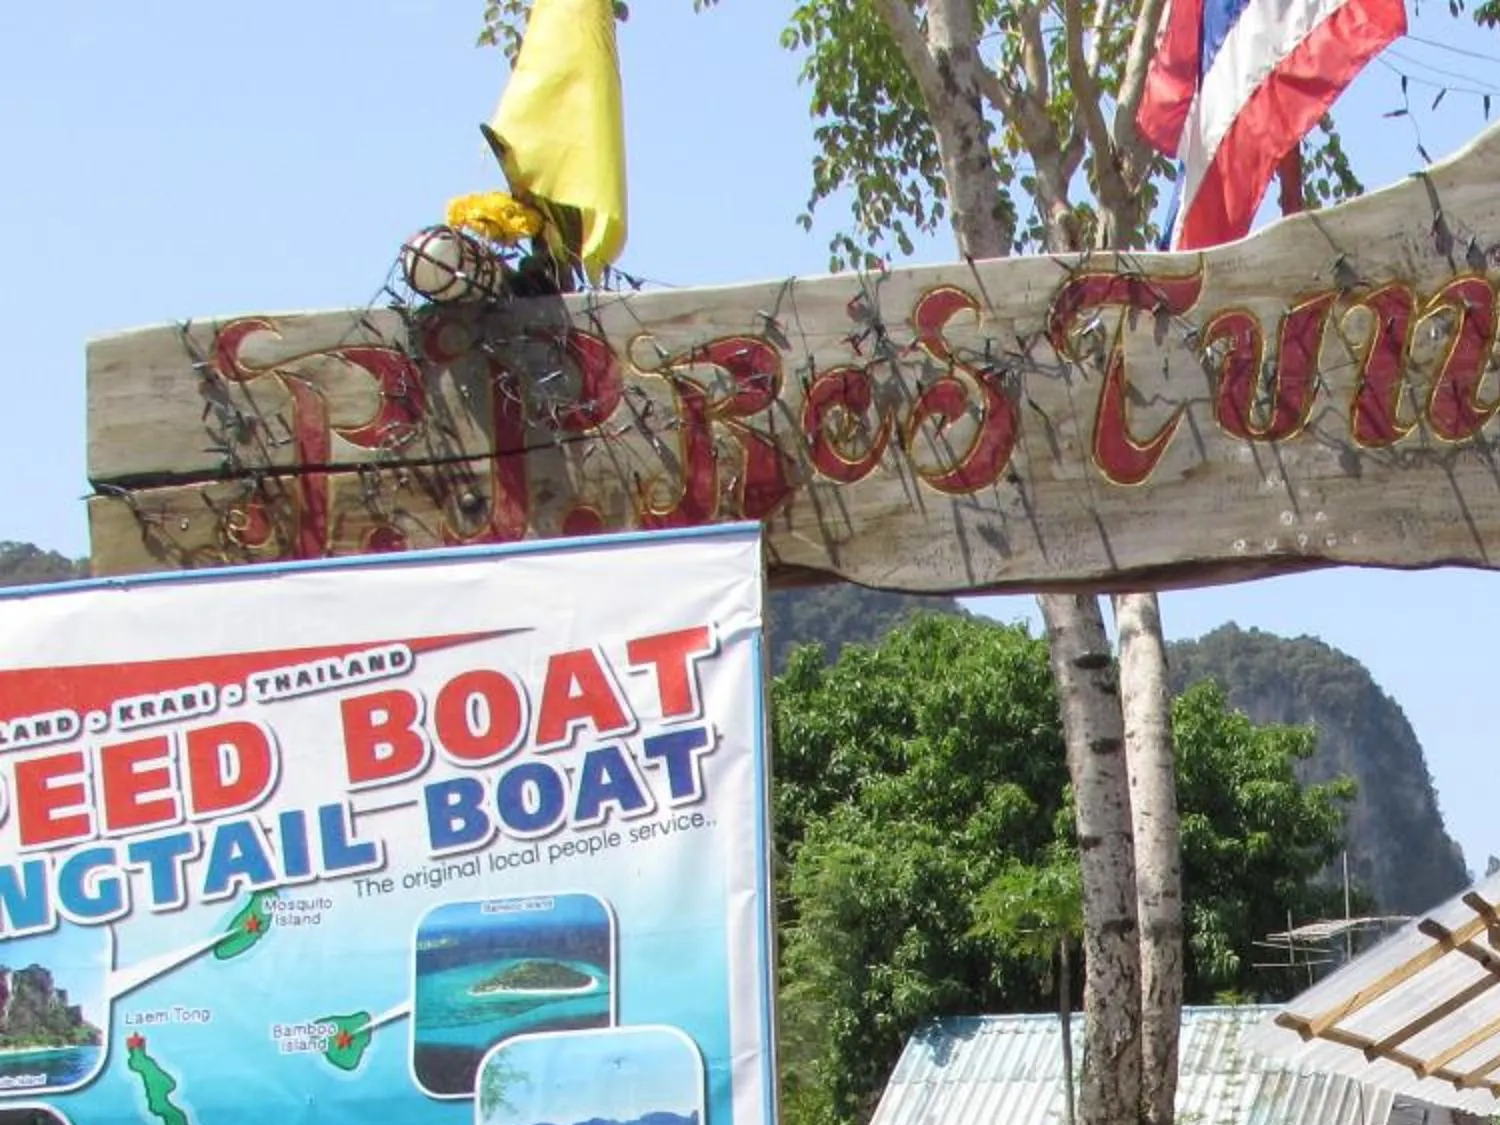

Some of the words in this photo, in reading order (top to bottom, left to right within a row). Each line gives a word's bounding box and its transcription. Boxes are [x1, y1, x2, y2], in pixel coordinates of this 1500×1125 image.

[118, 694, 211, 722] KRABI
[254, 649, 407, 695] THAILAND
[340, 626, 710, 784] BOAT
[0, 803, 378, 931] NGTAIL
[424, 727, 707, 851] BOAT
[354, 877, 395, 898] The
[403, 860, 480, 891] original
[490, 845, 540, 872] local
[549, 831, 621, 865] people
[264, 897, 333, 912] Mosquito
[125, 1011, 169, 1025] Laem
[174, 1007, 210, 1023] Tong
[273, 1023, 337, 1038] Bamboo
